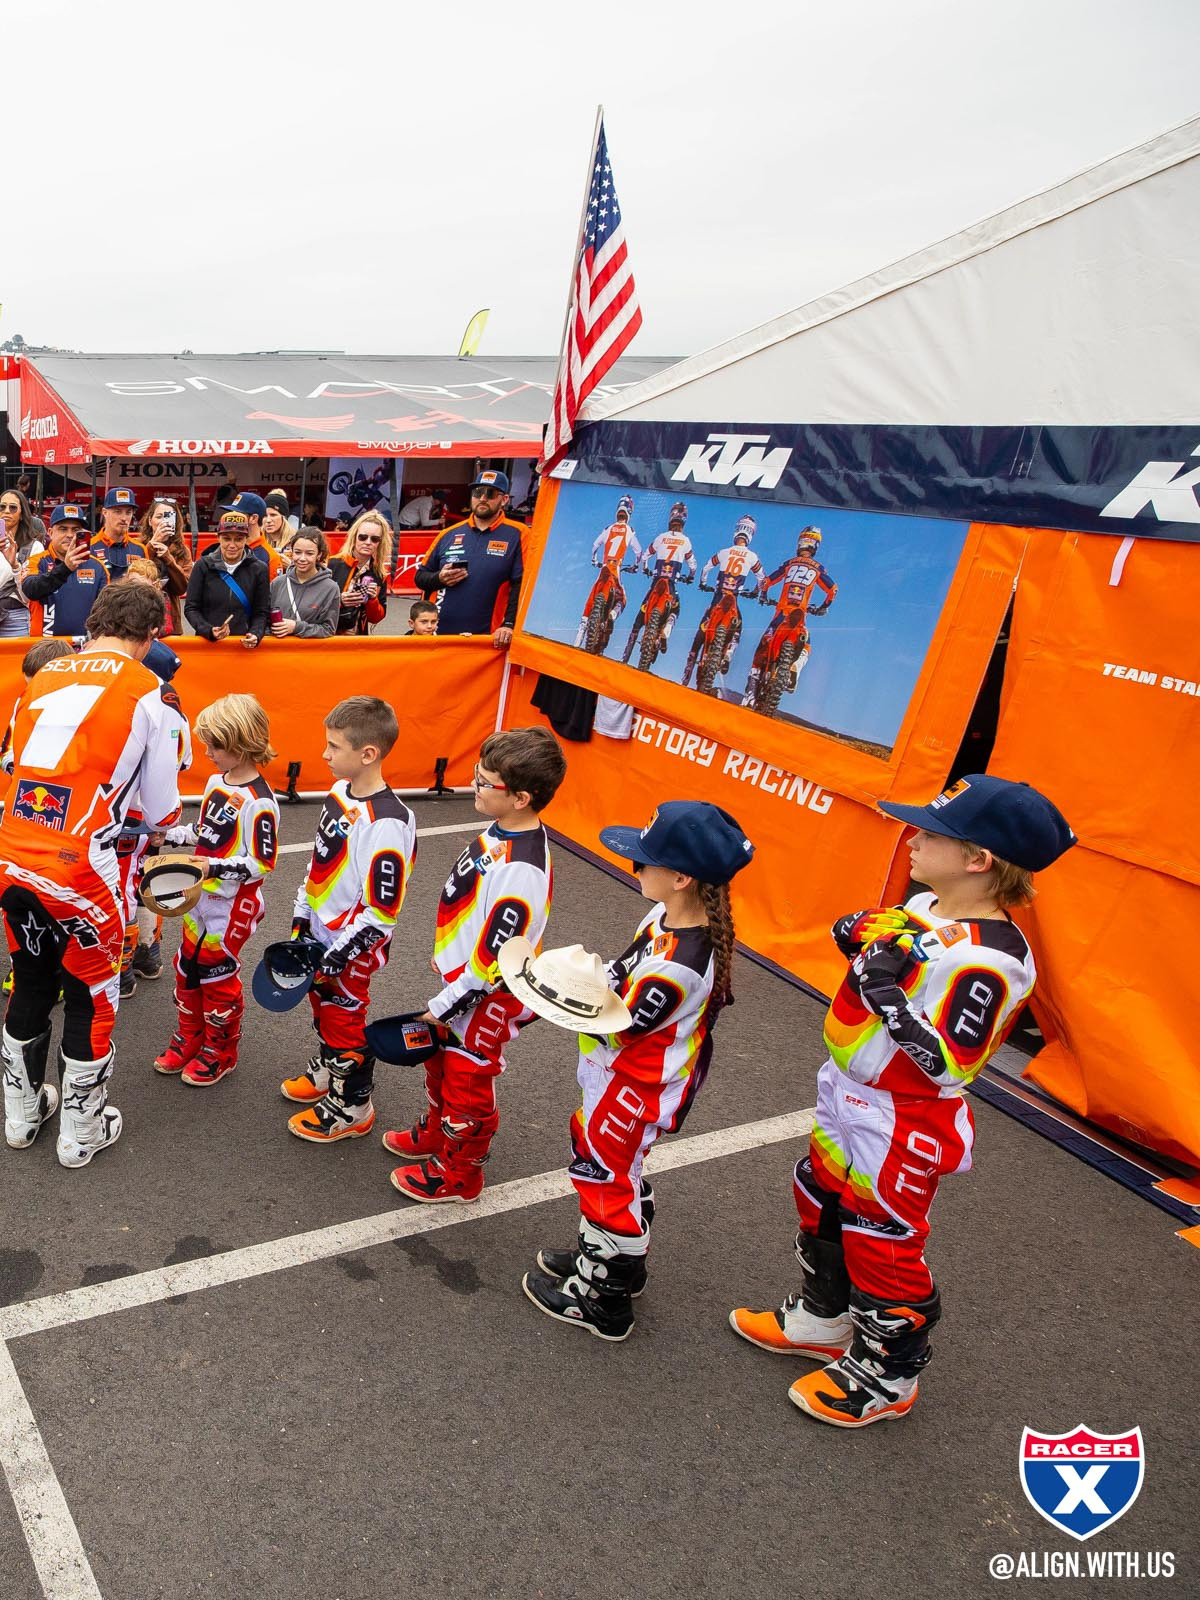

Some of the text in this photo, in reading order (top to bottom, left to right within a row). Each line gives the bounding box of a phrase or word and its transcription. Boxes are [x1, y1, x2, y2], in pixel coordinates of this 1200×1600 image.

[30, 414, 58, 440] HONDA
[157, 439, 274, 454] HONDA
[670, 433, 794, 489] KTM
[119, 462, 228, 478] HONDA
[1099, 444, 1200, 524] K
[608, 535, 624, 557] 1
[665, 545, 679, 563] 7
[725, 557, 745, 576] 16
[784, 565, 817, 586] 929
[43, 603, 55, 636] ING
[41, 658, 124, 675] SEXTON
[1102, 663, 1200, 697] TEAM STA
[19, 682, 106, 770] 1
[632, 713, 718, 768] ACTORY
[225, 806, 237, 816] 5
[339, 820, 350, 831] 4
[261, 819, 273, 856] TLD
[481, 855, 492, 866] 3
[380, 859, 395, 900] TLD
[57, 915, 101, 949] KTM
[229, 897, 256, 940] TLD
[491, 906, 519, 950] TLD
[841, 911, 863, 936] TLD
[349, 954, 373, 980] TL
[474, 1001, 506, 1048] TLD
[631, 987, 667, 1028] TLD
[954, 980, 993, 1039] TLD
[599, 1086, 647, 1144] TLD
[895, 1130, 943, 1195] TLD
